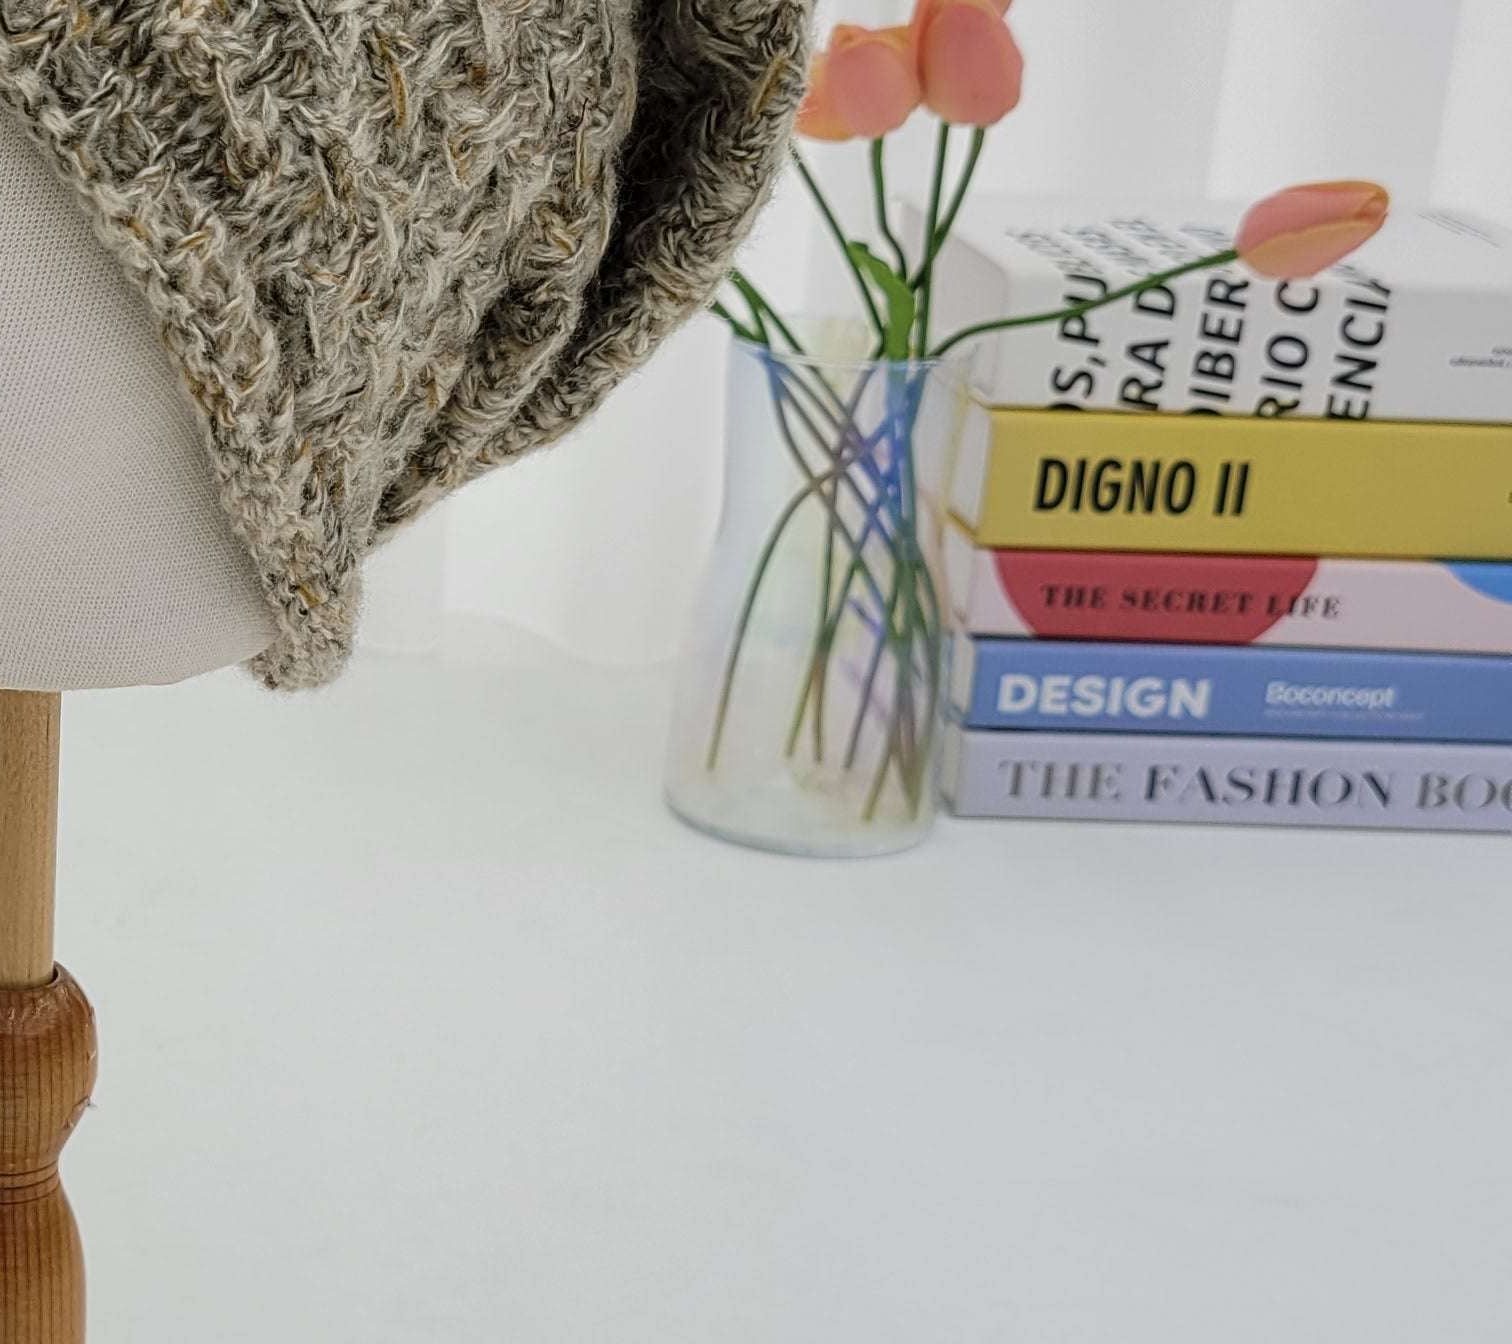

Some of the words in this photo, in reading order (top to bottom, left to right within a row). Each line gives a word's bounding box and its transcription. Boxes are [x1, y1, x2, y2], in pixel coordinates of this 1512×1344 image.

[1186, 278, 1250, 415] IBER
[1046, 356, 1107, 412] S,
[1034, 458, 1196, 514] DIGNO
[1213, 461, 1250, 516] II
[1041, 583, 1106, 608] THE
[1121, 587, 1253, 614] SECRET
[1266, 594, 1340, 618] LIFE
[998, 674, 1211, 718] DESIGN
[999, 760, 1122, 798] THE
[1417, 771, 1512, 812] BO
